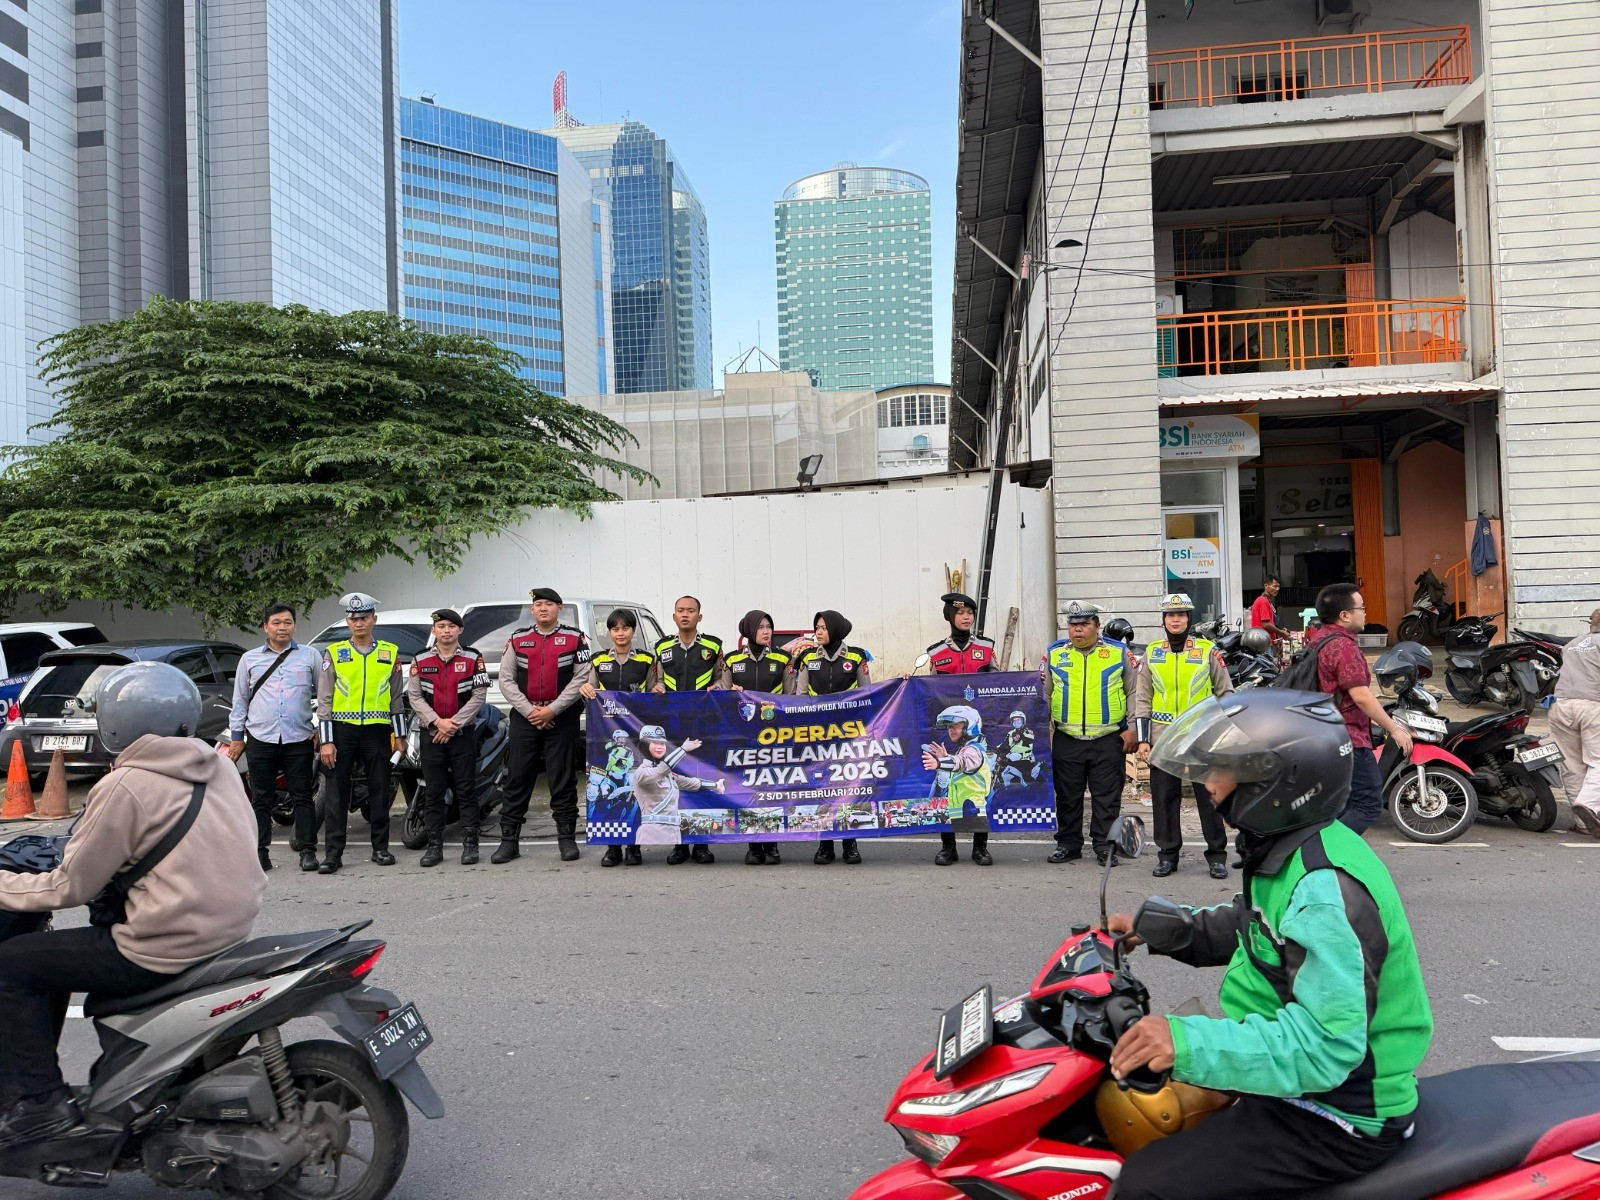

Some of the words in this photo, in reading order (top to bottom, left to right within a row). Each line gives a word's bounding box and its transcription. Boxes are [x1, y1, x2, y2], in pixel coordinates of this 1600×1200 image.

[1191, 432, 1213, 440] BANK
[1214, 430, 1245, 439] SYARIAH
[1191, 438, 1233, 446] INDONESIA
[1228, 444, 1245, 452] ATM
[1319, 476, 1349, 486] TOKO
[1171, 548, 1191, 560] BSI
[977, 687, 1015, 695] MANDALA
[1016, 685, 1037, 693] JAYA
[785, 705, 817, 714] DITLANTAS
[817, 703, 837, 712] POLDA
[837, 701, 858, 710] METRO
[858, 699, 872, 707] JAYA
[757, 720, 868, 746] OPERASI
[725, 738, 903, 767] KESELAMATAN
[741, 766, 808, 787] JAYA
[828, 760, 889, 782] 2026
[758, 792, 765, 800] 2
[766, 791, 783, 800] S/D
[785, 791, 797, 800] 15
[798, 788, 846, 799] FEBRUARI
[848, 786, 873, 796] 2026
[369, 1040, 381, 1056] E
[380, 1021, 405, 1047] 3024
[402, 1011, 418, 1030] XN
[1046, 1181, 1104, 1200] HONDA
